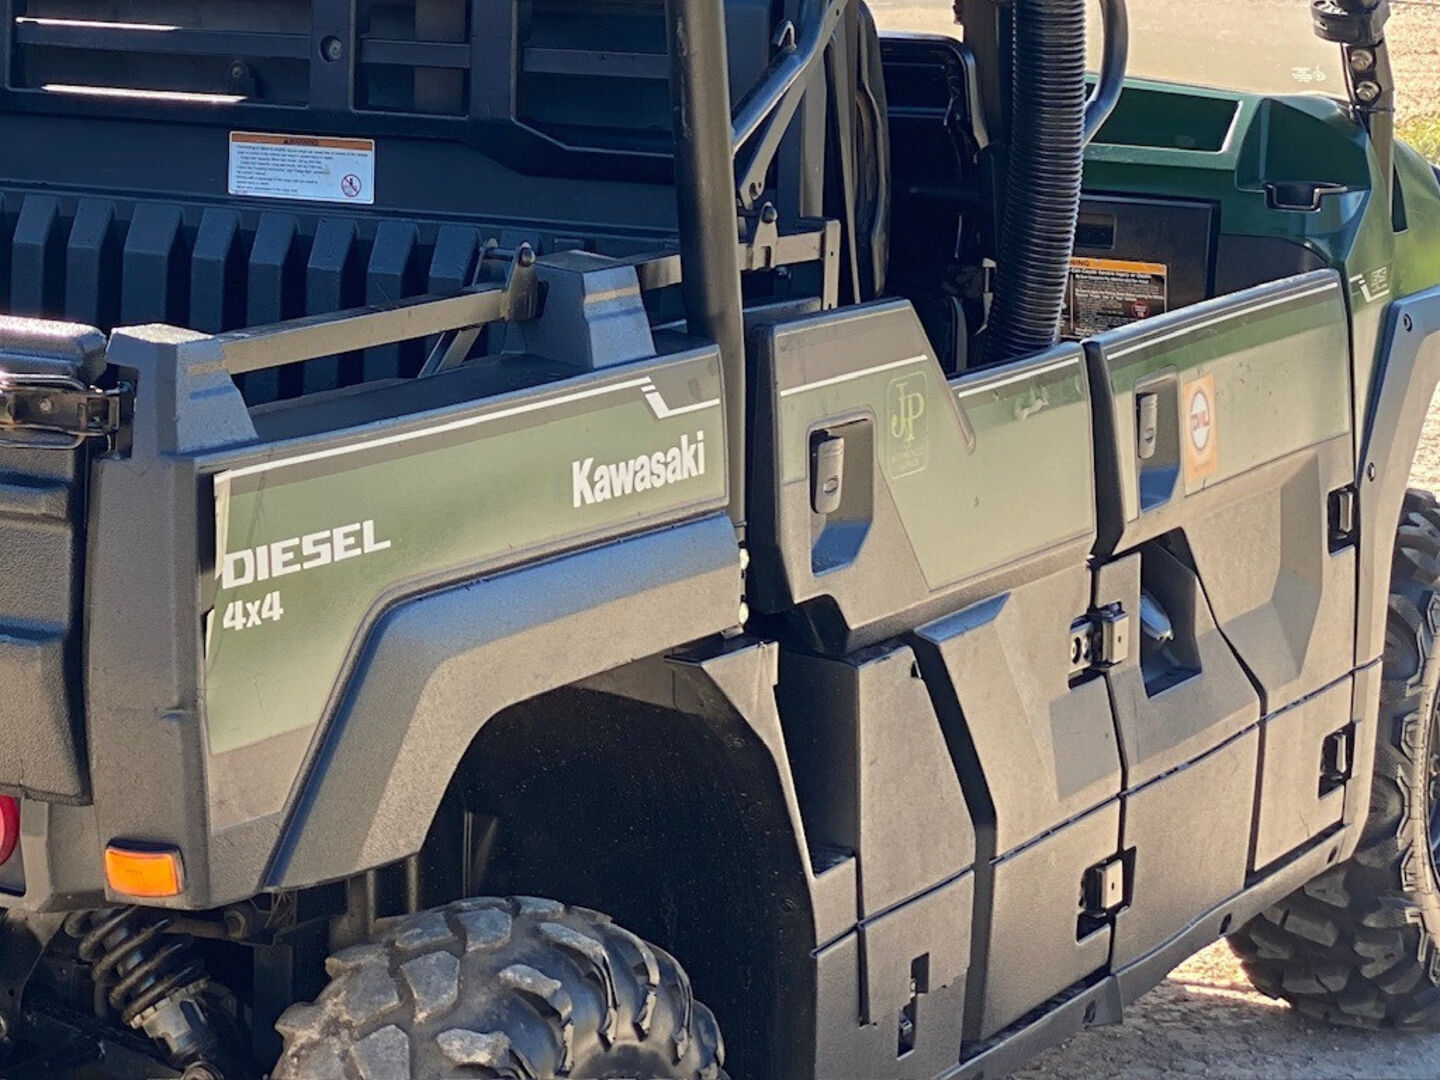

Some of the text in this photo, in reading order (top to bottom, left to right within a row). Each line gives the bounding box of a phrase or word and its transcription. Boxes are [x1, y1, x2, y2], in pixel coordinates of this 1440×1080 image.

[571, 430, 705, 508] Kawasaki
[221, 519, 392, 590] DIESEL
[222, 590, 285, 632] 4x4
